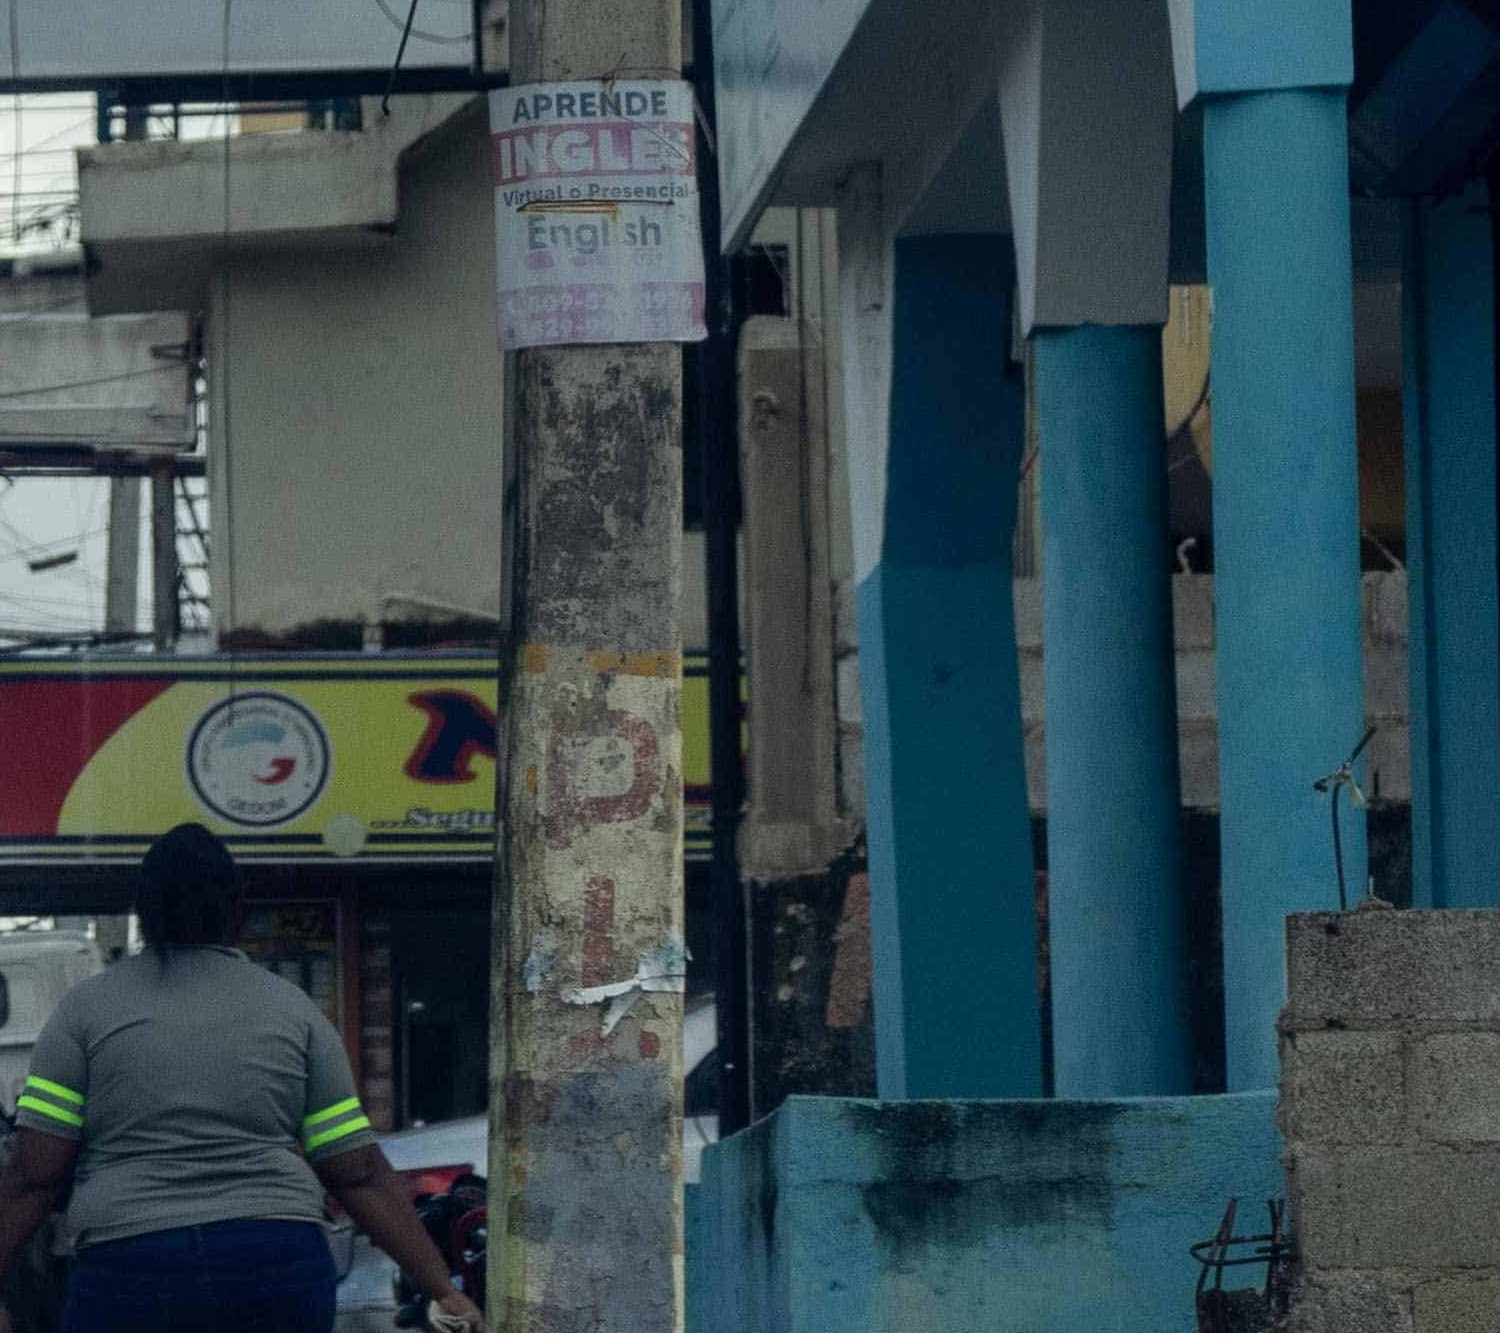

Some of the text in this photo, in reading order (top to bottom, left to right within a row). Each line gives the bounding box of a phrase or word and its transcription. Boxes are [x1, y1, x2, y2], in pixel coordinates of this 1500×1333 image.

[512, 89, 669, 124] APRENDE
[503, 184, 563, 207] Virtual
[588, 181, 689, 200] Presencial
